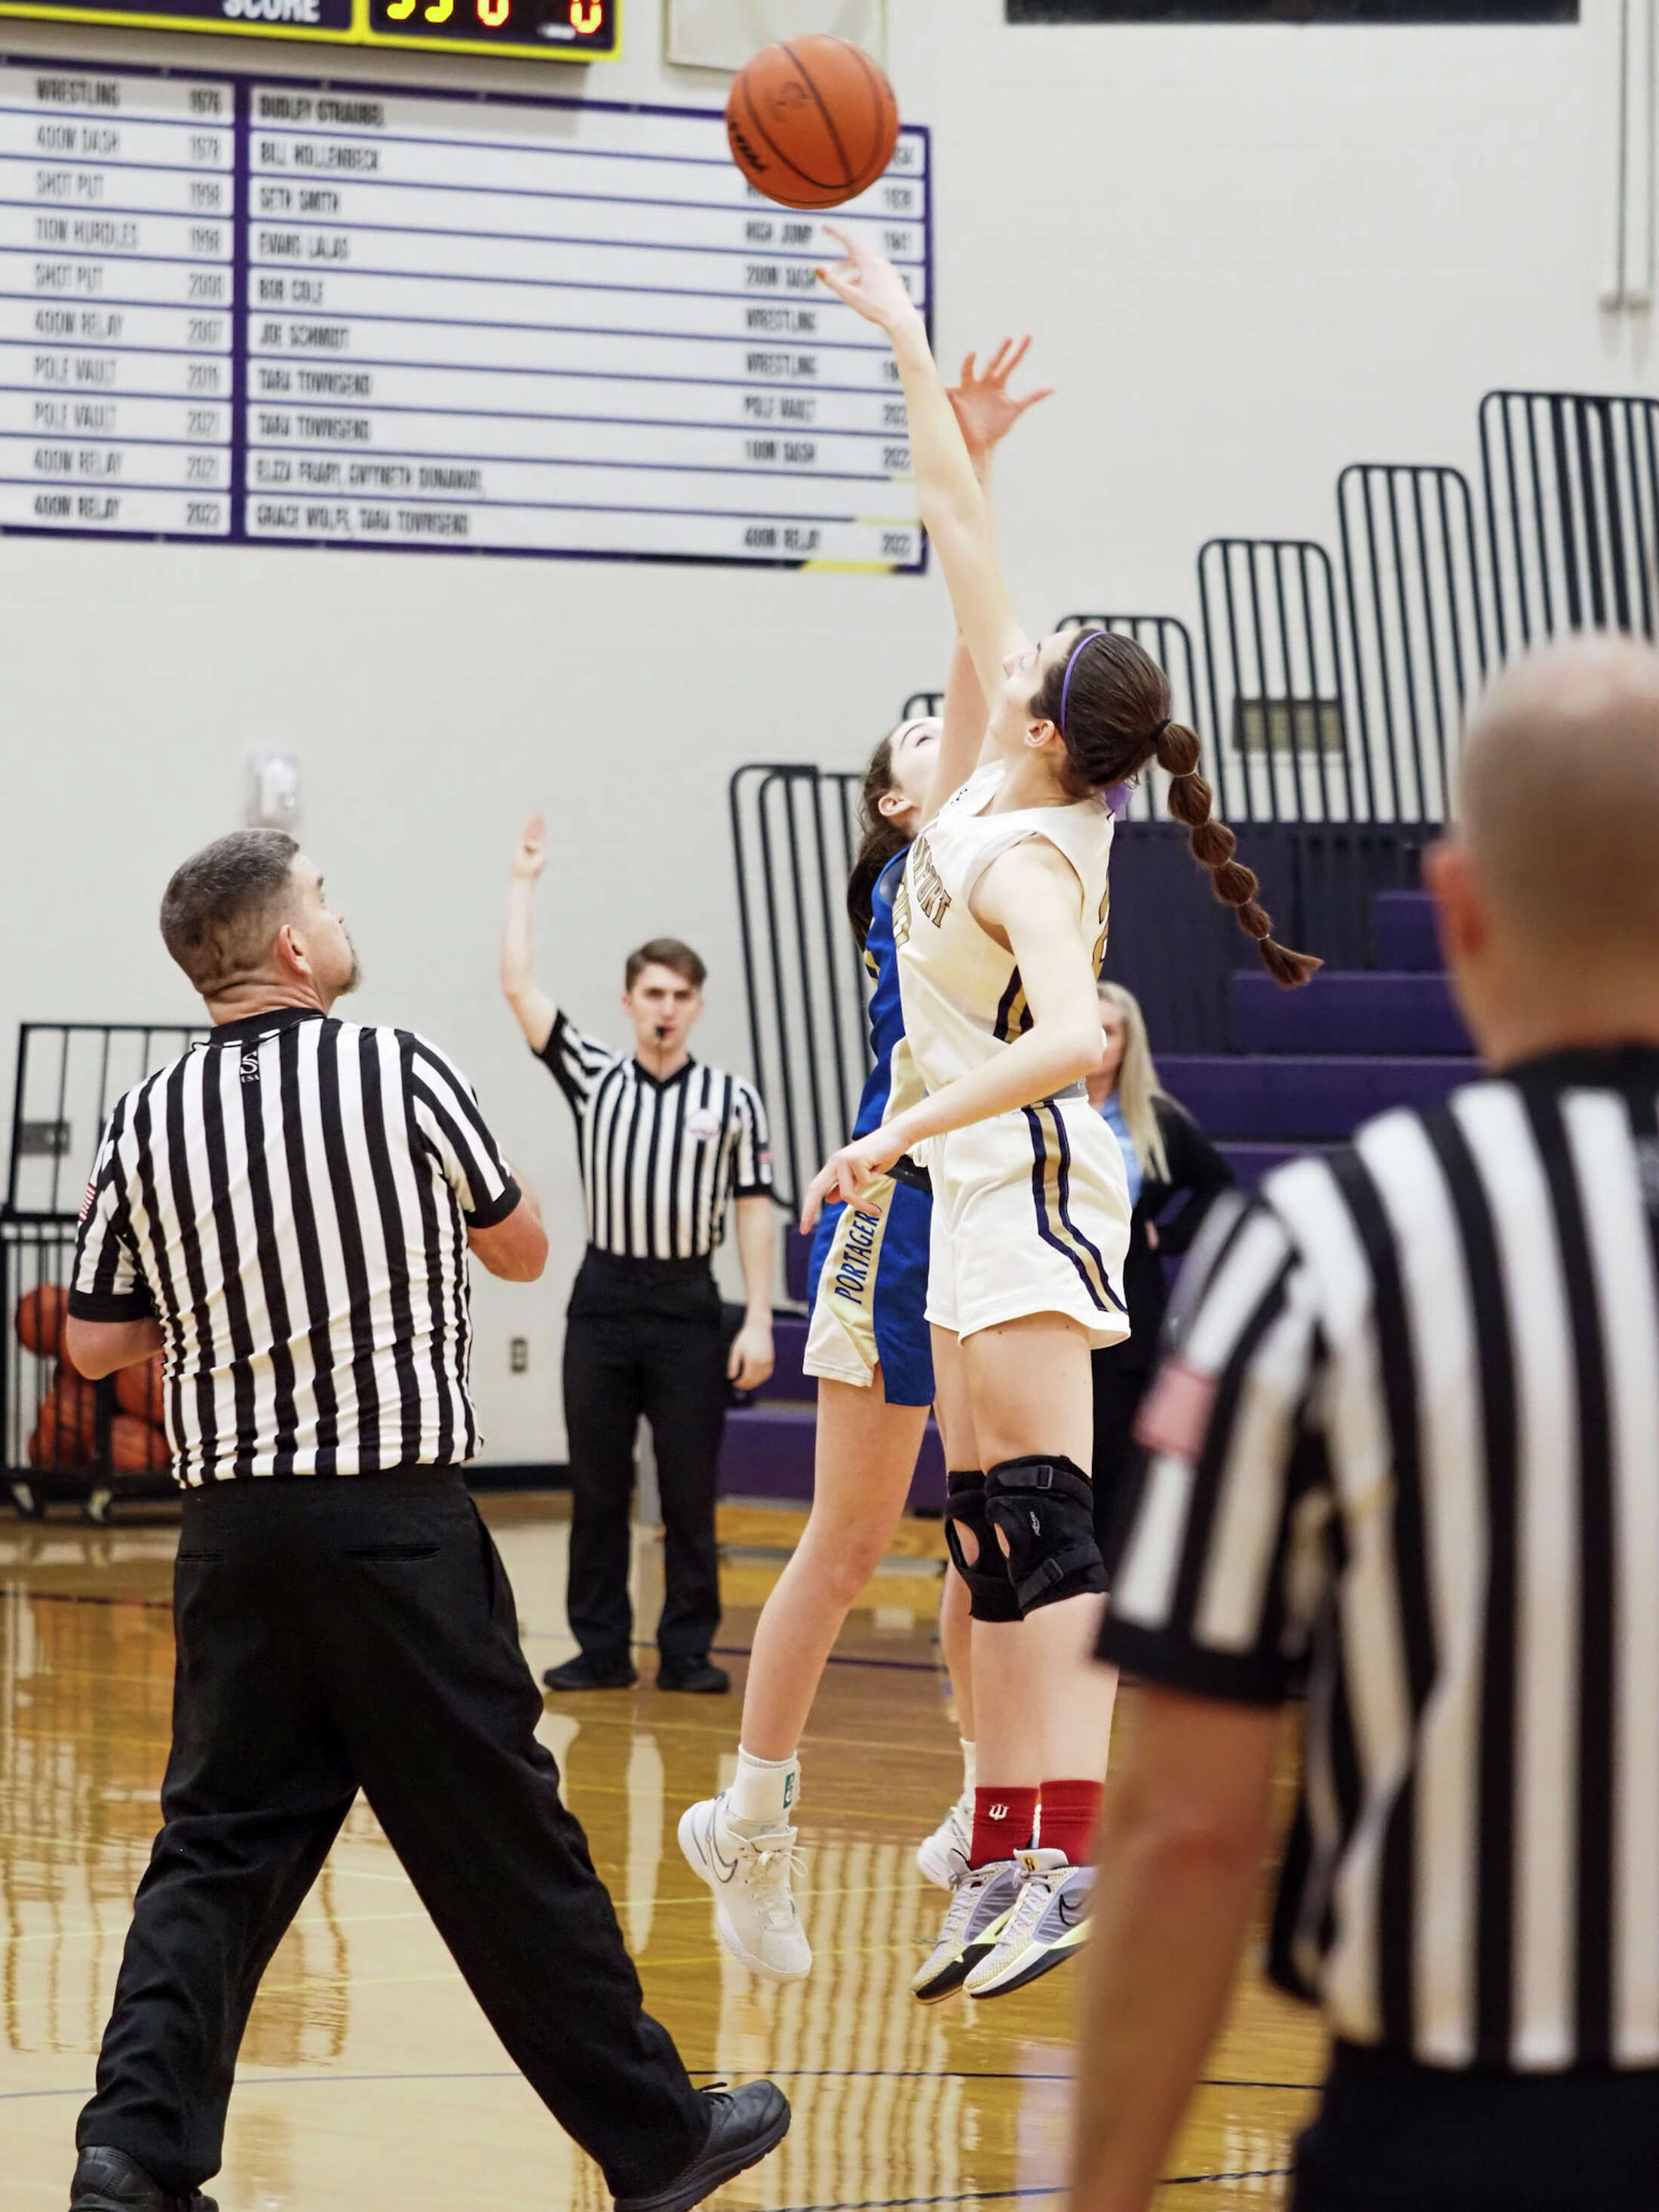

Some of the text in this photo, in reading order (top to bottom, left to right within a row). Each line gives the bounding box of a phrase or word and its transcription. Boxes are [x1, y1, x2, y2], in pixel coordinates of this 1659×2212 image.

[36, 78, 121, 108] WRESTLING
[36, 170, 104, 200] SHOT PUT
[299, 189, 339, 216] SMITH
[72, 218, 138, 250] HURDLES
[35, 262, 104, 293] SHOT PUT
[80, 311, 123, 339] RELAY
[746, 308, 816, 333] WRESTLING
[34, 355, 116, 385] POLE VAULT
[746, 352, 817, 378] WRESTLING
[297, 370, 370, 398] TOWNSEND
[33, 401, 116, 433] POLE VAULT
[296, 415, 370, 443] TOWNSEND
[78, 449, 121, 480] RELAY
[78, 495, 120, 522] RELAY
[783, 528, 820, 552] RELAY
